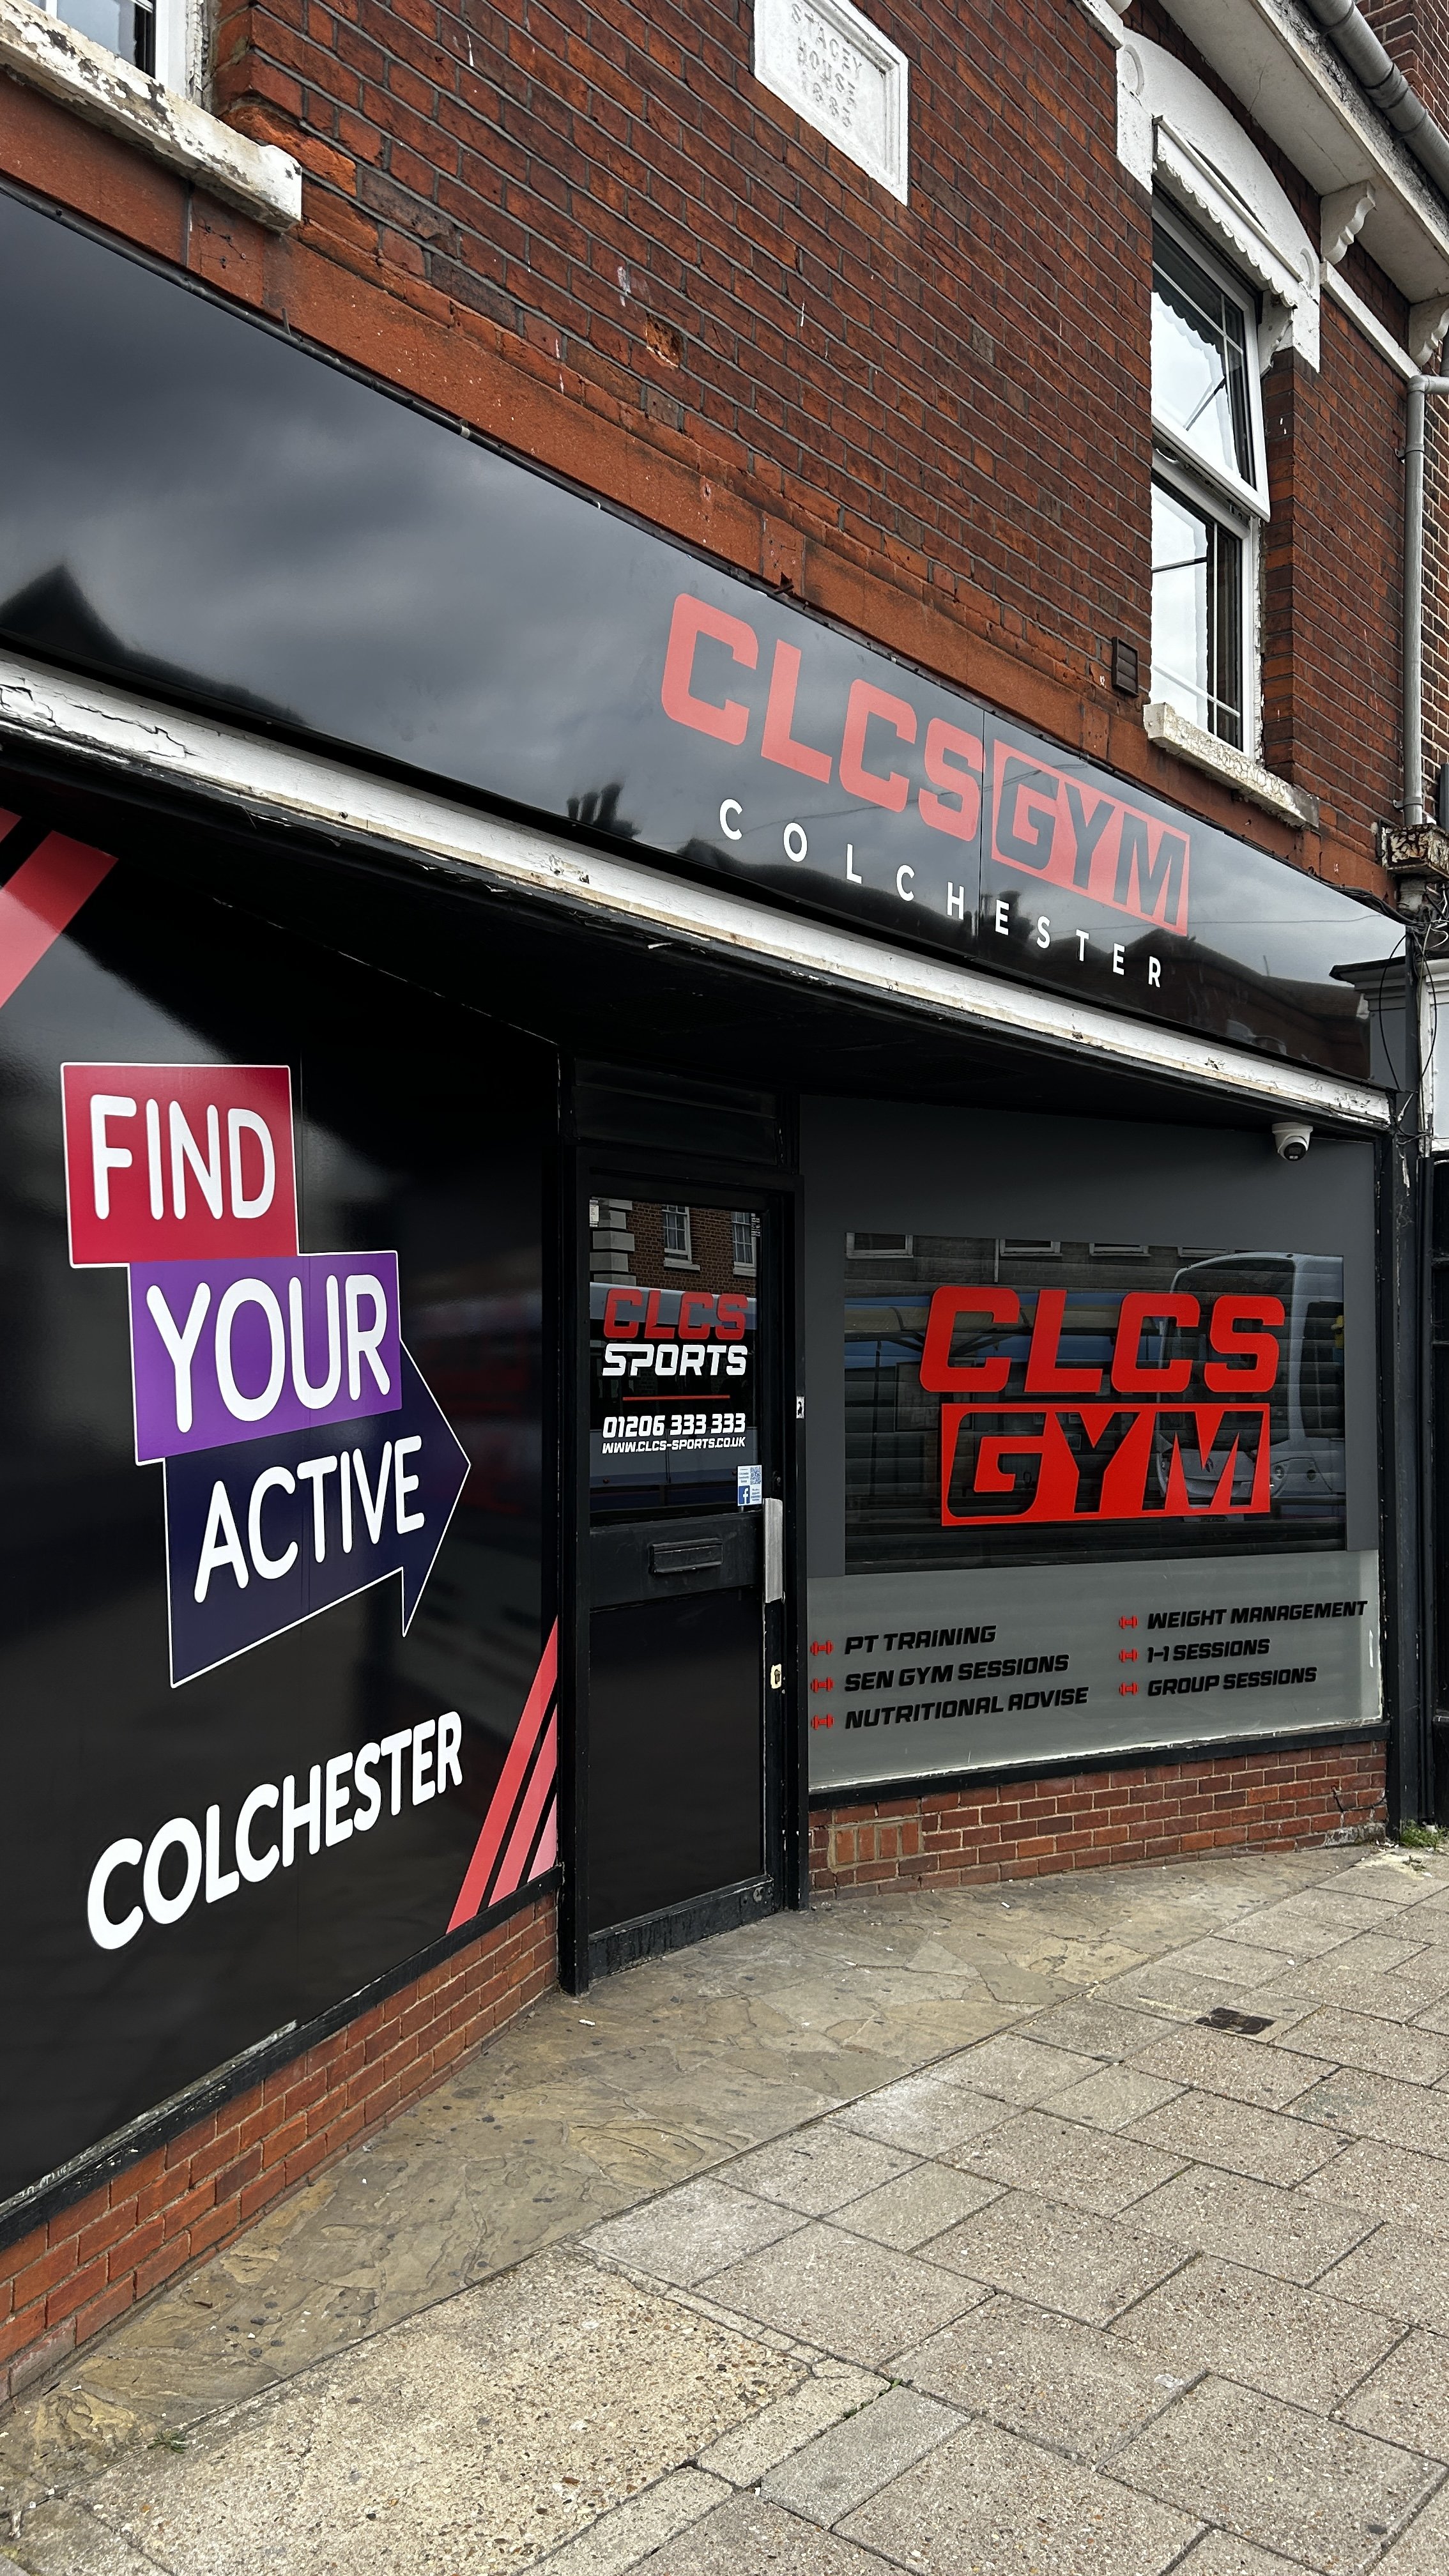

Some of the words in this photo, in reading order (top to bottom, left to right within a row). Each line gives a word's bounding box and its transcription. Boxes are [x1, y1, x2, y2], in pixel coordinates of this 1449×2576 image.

[791, 3, 862, 79] STACEY
[797, 36, 857, 109] HOUSE
[661, 593, 986, 842] CLCS
[995, 754, 1187, 928] GYM
[719, 799, 1162, 988] COLCHESTER
[89, 1094, 277, 1220] FIND
[603, 1288, 748, 1340] CLCS
[919, 1286, 1285, 1393] CLCS
[146, 1274, 391, 1434] YOUR
[602, 1344, 748, 1376] SPORTS
[602, 1415, 666, 1438] 01206
[670, 1414, 707, 1436] 333
[710, 1413, 746, 1434] 333
[602, 1436, 746, 1454] WWW.CLCS-SPORTS.CO.UK
[946, 1410, 1264, 1518] GYM
[194, 1435, 425, 1604] ACTIVE
[845, 1634, 879, 1655] PT
[884, 1625, 997, 1652] TRAINING
[1147, 1609, 1227, 1629] WEIGHT
[1230, 1600, 1368, 1624] MANAGEMENT
[845, 1670, 894, 1692] SEN
[898, 1664, 953, 1687] GYM
[958, 1654, 1070, 1681] SESSIONS
[1147, 1646, 1169, 1662] 1-1
[1173, 1638, 1270, 1661] SESSIONS
[845, 1696, 1004, 1729] NUTRITIONAL
[1008, 1687, 1089, 1711] ADVISE
[1147, 1675, 1219, 1696] GROUP
[1223, 1667, 1317, 1690] SESSIONS
[87, 1711, 463, 1950] COLCHESTER
